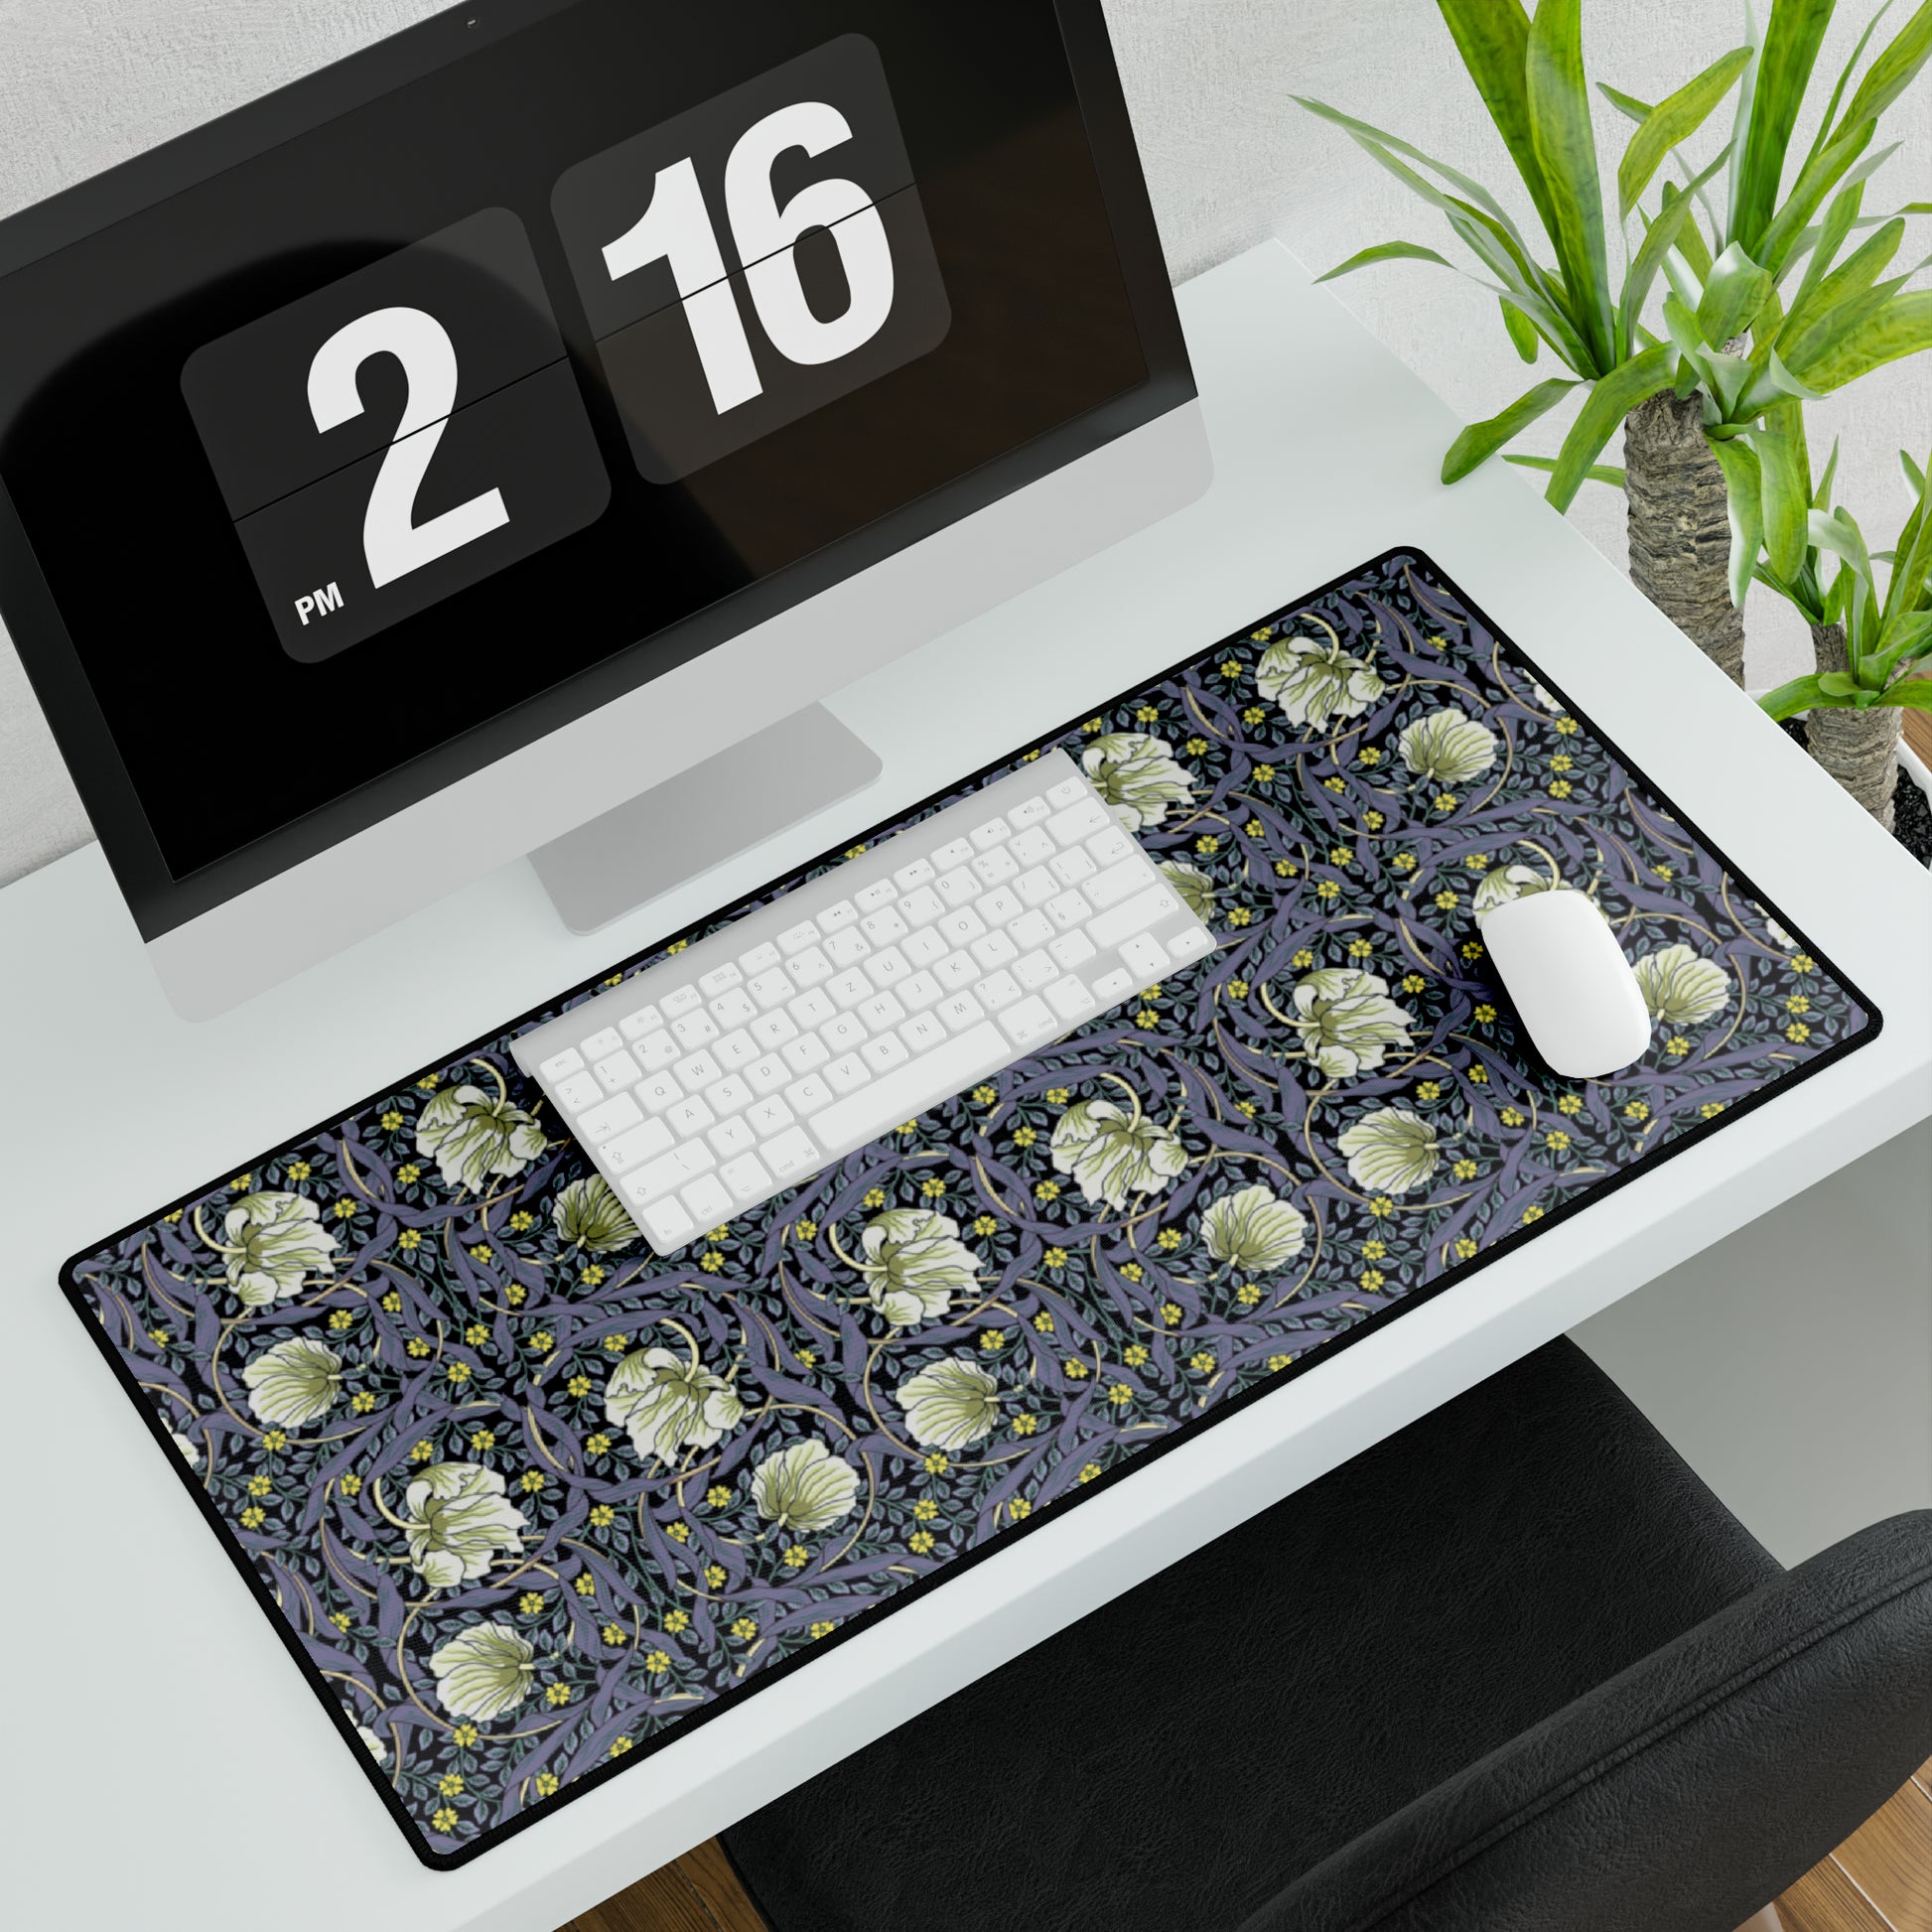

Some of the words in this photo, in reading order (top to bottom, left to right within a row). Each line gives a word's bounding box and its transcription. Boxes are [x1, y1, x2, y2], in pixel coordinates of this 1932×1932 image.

[308, 307, 509, 588] 2
[602, 102, 894, 415] 16
[295, 582, 344, 625] PM
[638, 1043, 647, 1053] 2
[676, 1023, 686, 1033] 3
[716, 1001, 725, 1011] 4
[742, 1003, 751, 1012] $
[754, 981, 762, 991] 5
[791, 961, 800, 970] 6
[828, 940, 836, 950] 7
[866, 920, 875, 929] 8
[903, 900, 911, 909] 9
[940, 880, 949, 889] 0
[655, 1086, 665, 1096] Q
[691, 1064, 704, 1075] W
[731, 1044, 741, 1054] E
[770, 1024, 780, 1033] R
[807, 1002, 816, 1012] T
[846, 982, 856, 992] Z
[883, 961, 894, 971] U
[958, 920, 968, 930] O
[995, 900, 1004, 910] P
[684, 1109, 694, 1119] A
[722, 1087, 732, 1097] S
[760, 1066, 770, 1076] D
[798, 1044, 807, 1054] F
[837, 1024, 847, 1034] G
[875, 1004, 886, 1014] H
[914, 983, 922, 993] J
[950, 962, 961, 972] K
[988, 943, 998, 952] L
[725, 1128, 735, 1139] Y
[763, 1108, 775, 1118] X
[803, 1086, 813, 1096] C
[840, 1065, 850, 1075] V
[879, 1044, 889, 1054] B
[916, 1024, 928, 1035] N
[954, 1003, 967, 1015] M
[778, 1160, 795, 1173] cmd
